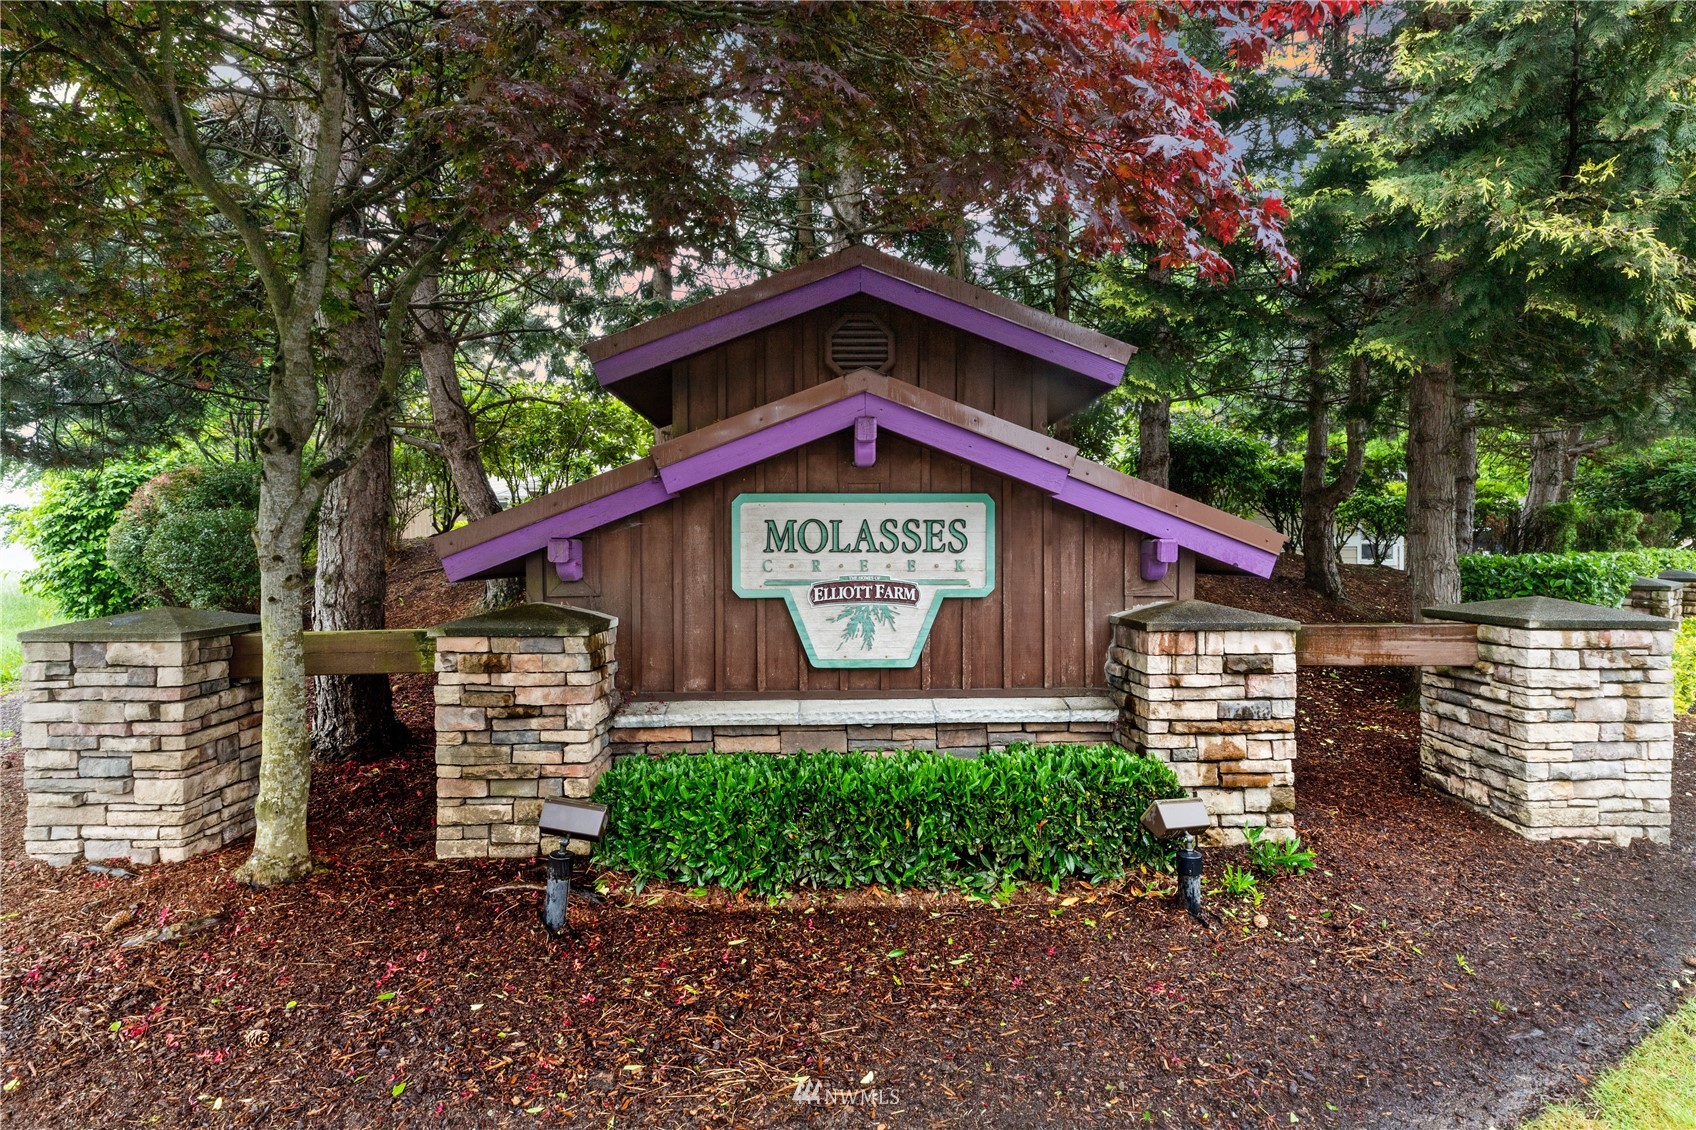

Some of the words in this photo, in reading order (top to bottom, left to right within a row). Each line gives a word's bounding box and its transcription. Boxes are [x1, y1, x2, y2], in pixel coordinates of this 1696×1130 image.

[763, 518, 969, 554] MOLASSES
[813, 585, 872, 602] ELLIOTT
[875, 584, 916, 601] FARM
